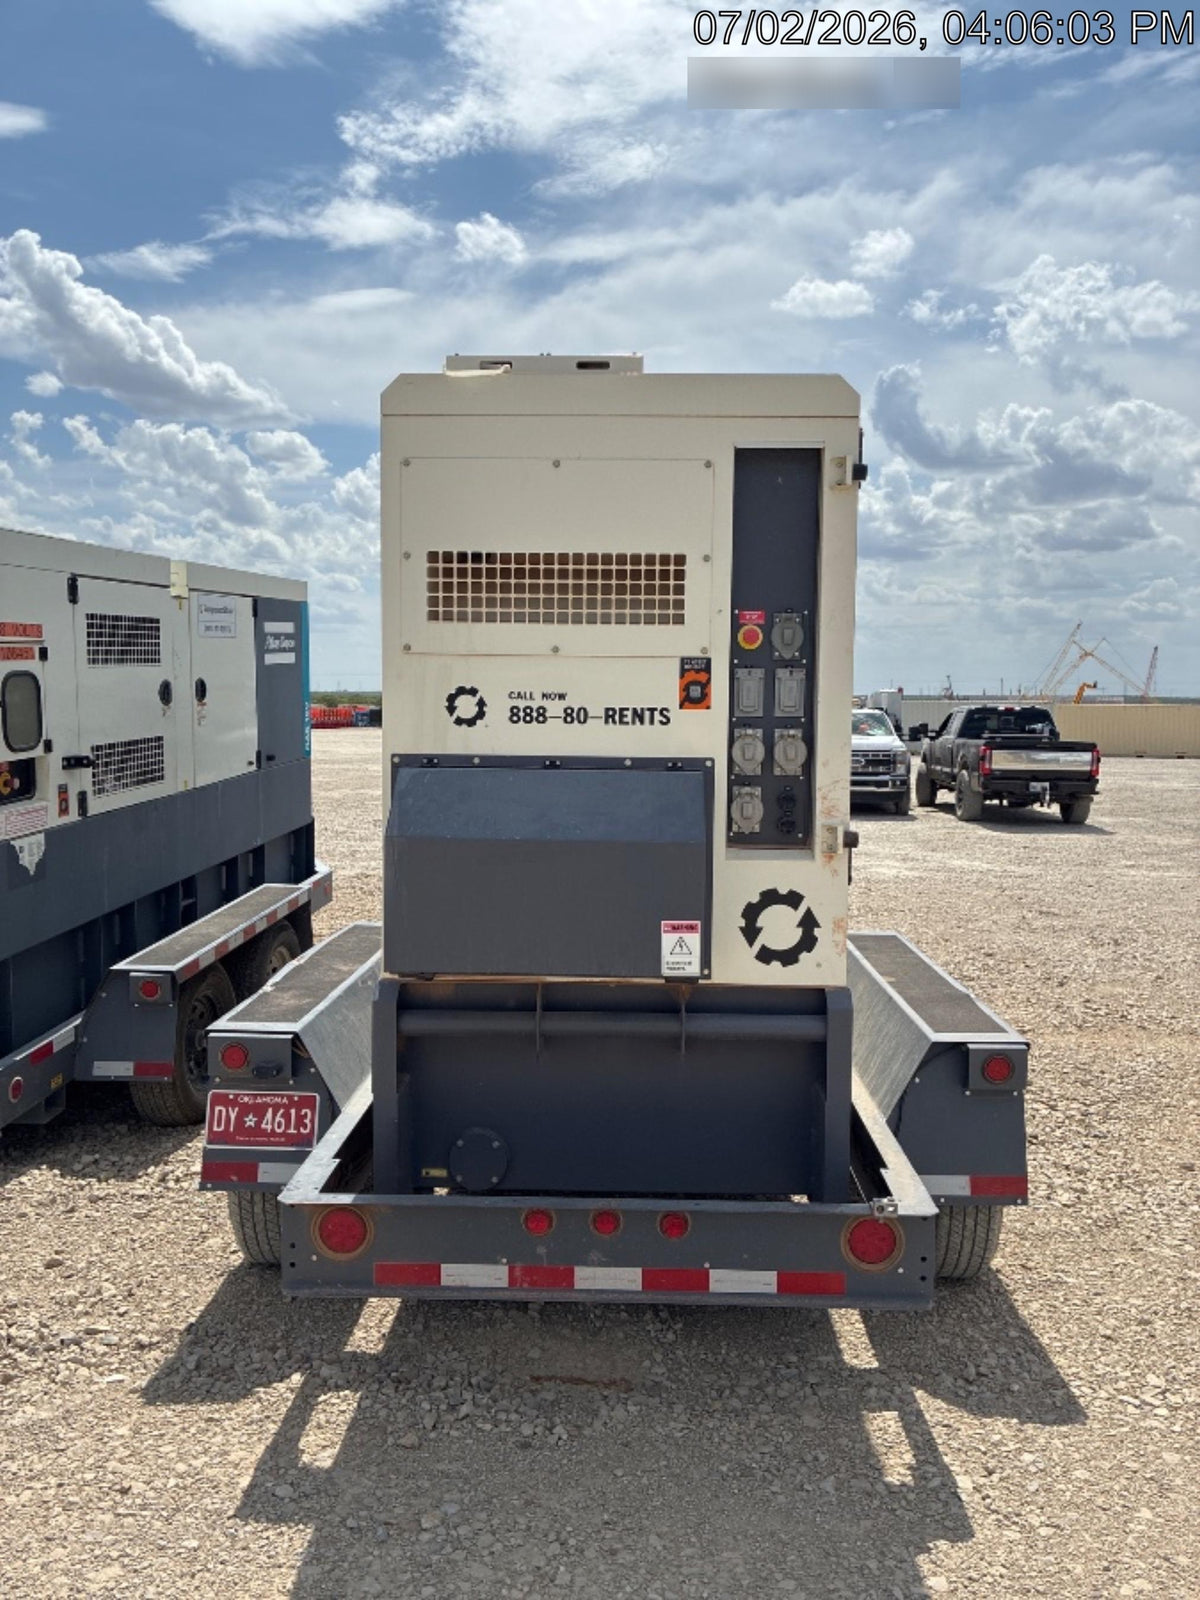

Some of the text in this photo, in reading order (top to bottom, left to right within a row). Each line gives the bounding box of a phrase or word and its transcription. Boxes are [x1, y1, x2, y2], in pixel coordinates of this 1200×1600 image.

[508, 691, 568, 701] CALL NOW
[508, 705, 671, 726] 888-80-RENTS
[237, 1095, 289, 1105] OKLAHOMA
[212, 1105, 312, 1134] DY 4613
